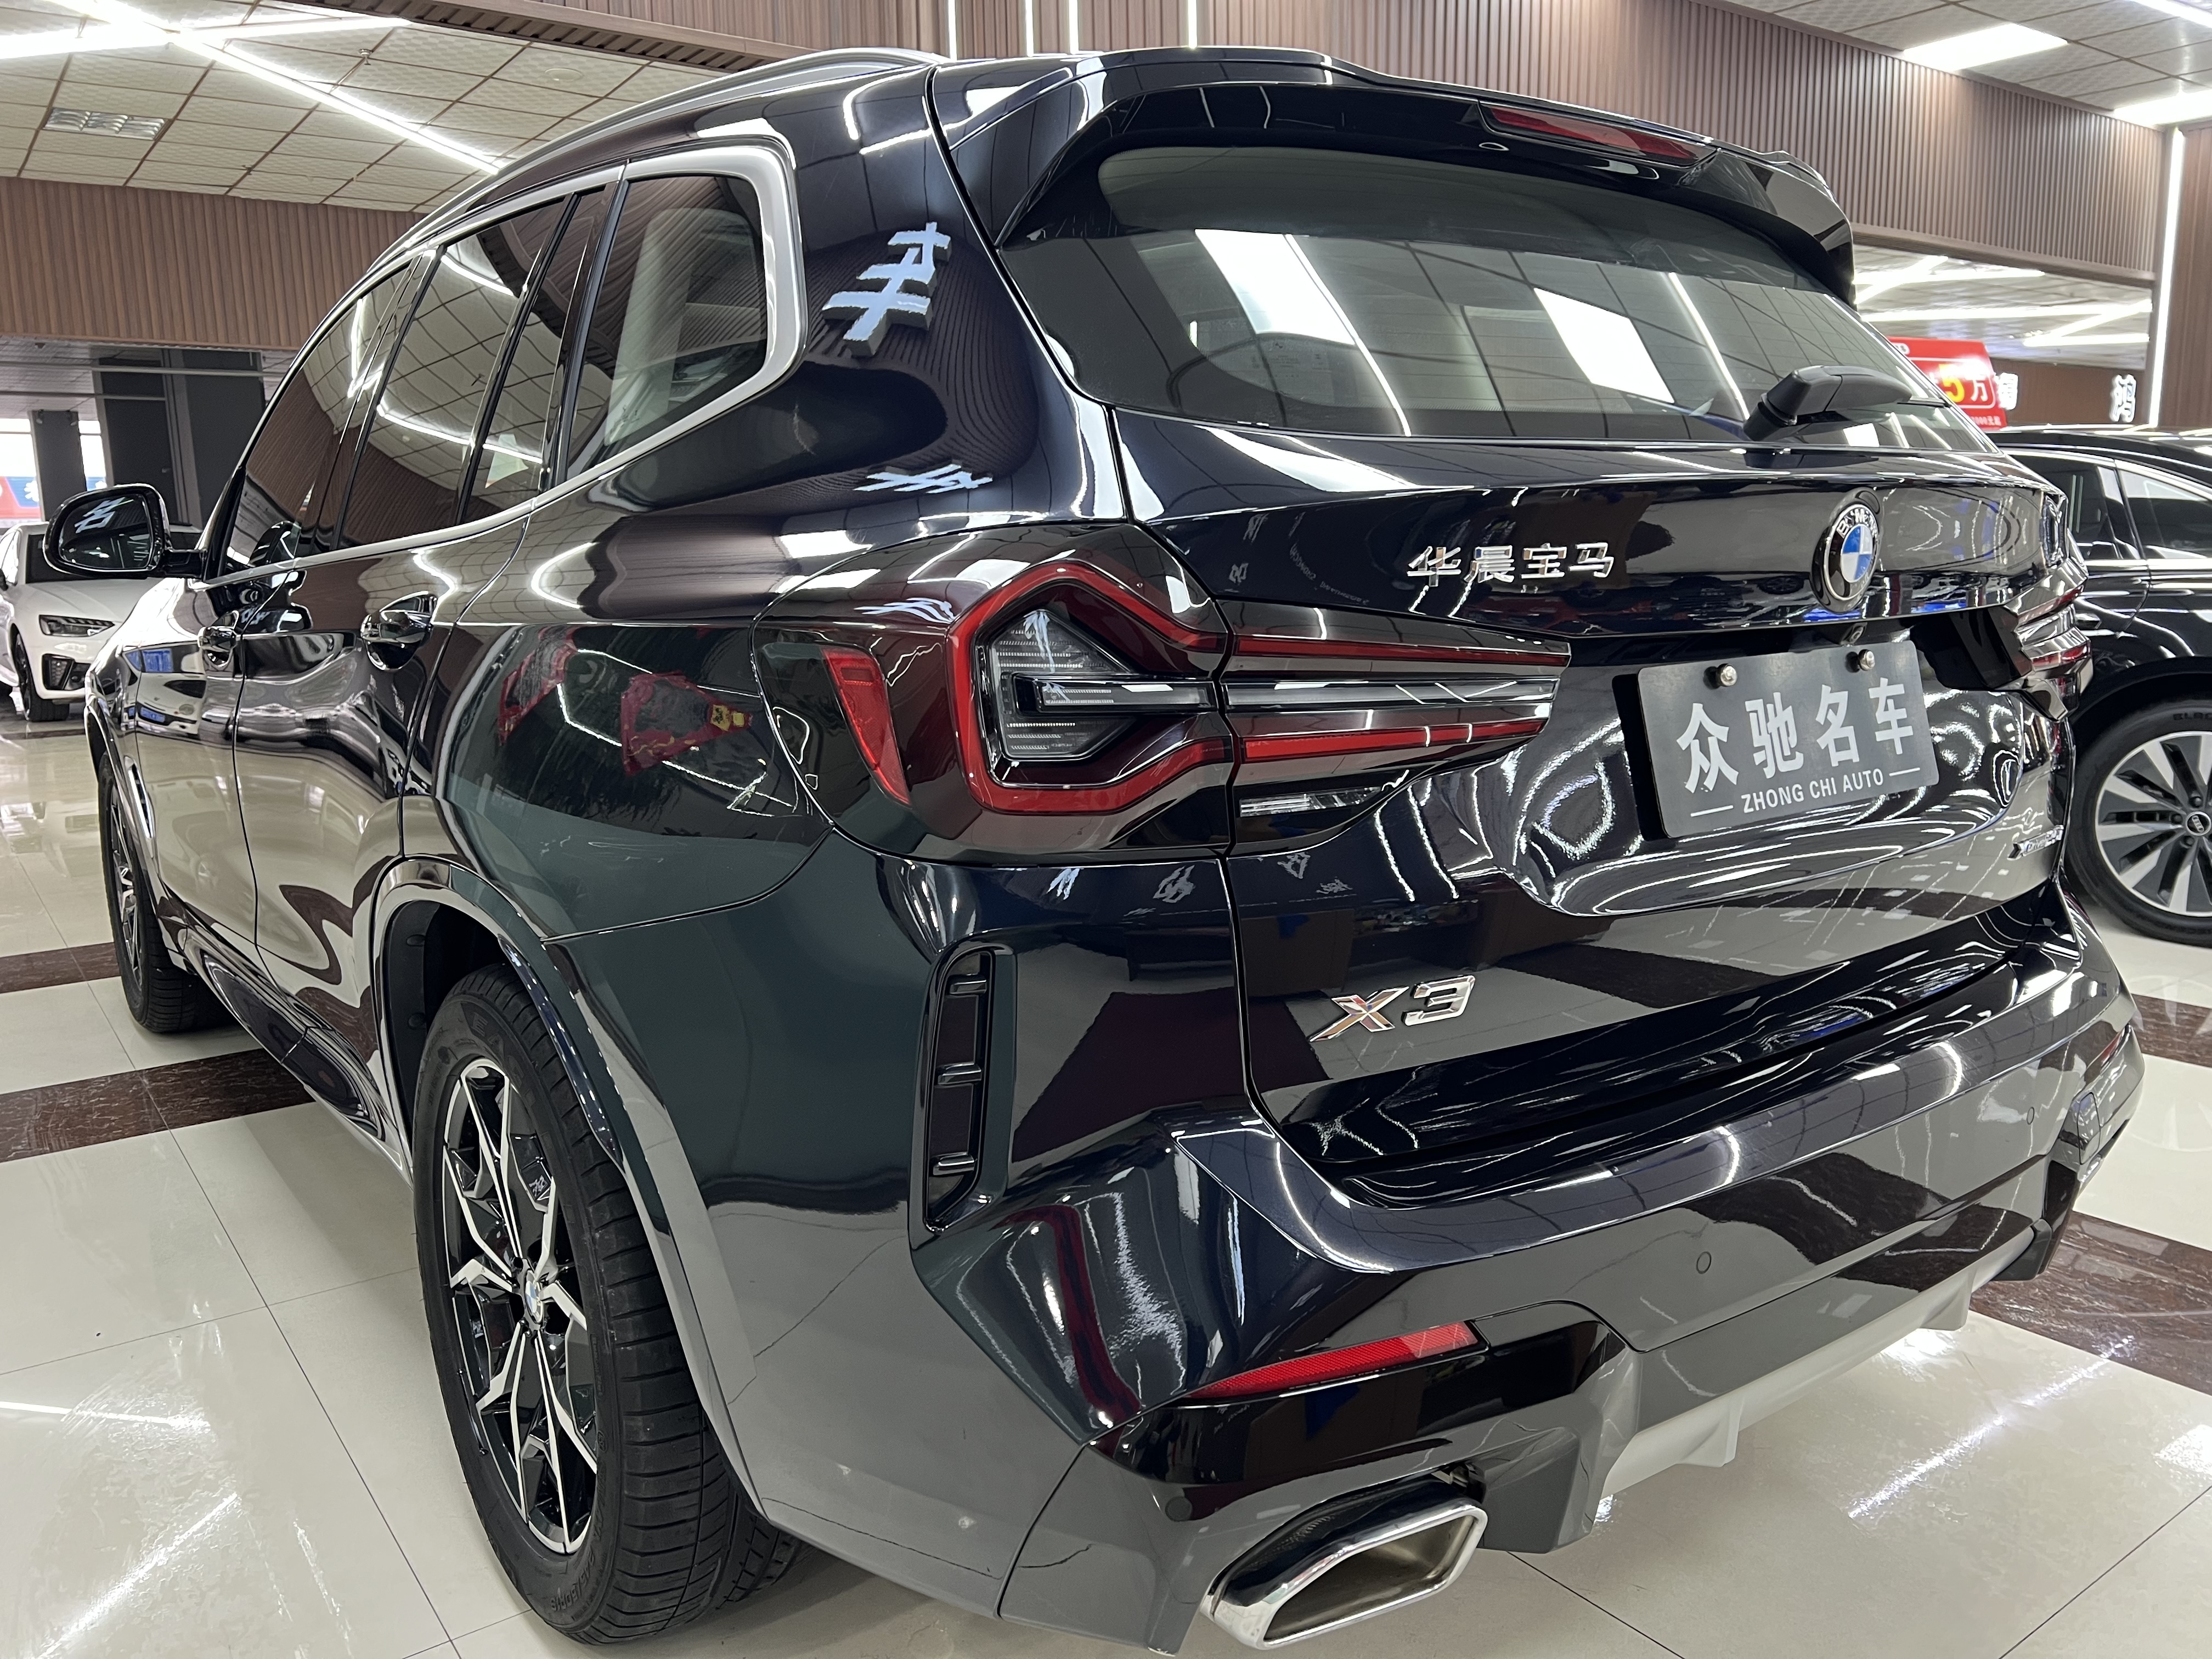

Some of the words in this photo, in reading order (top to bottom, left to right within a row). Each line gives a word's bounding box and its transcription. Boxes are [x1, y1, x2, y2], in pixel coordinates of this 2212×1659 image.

[1929, 364, 1989, 403] 5万
[1408, 542, 1614, 586] 华晨宝马
[1677, 678, 1914, 793] 众驰名车
[1741, 783, 1804, 814] ZHONG
[1810, 778, 1836, 799] CHI
[1843, 768, 1884, 794] AUTO
[1309, 975, 1476, 1042] X3
